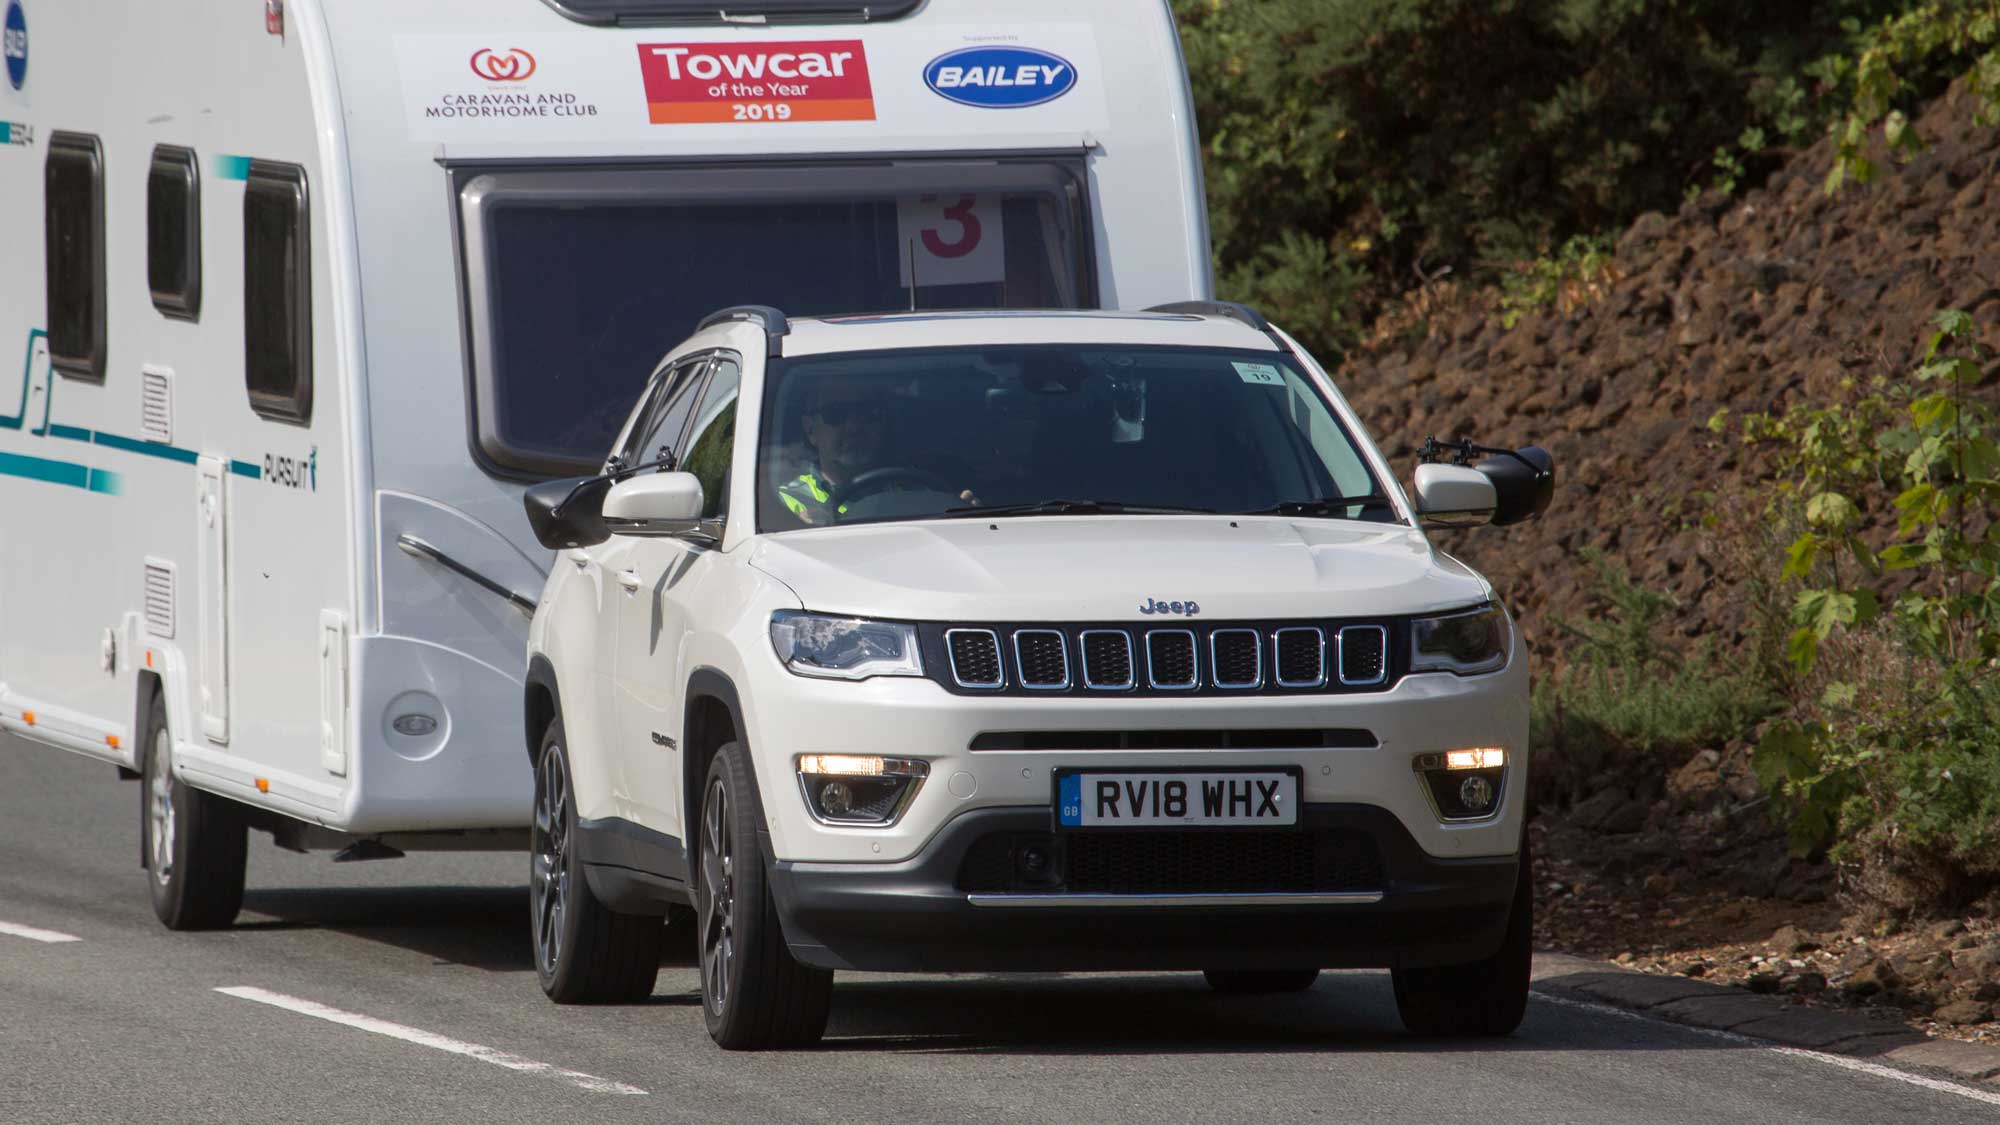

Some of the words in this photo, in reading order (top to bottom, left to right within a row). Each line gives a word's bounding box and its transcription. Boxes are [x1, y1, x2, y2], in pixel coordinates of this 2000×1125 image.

[652, 47, 852, 80] Towcar
[935, 64, 1065, 88] BAILEY
[442, 94, 530, 106] CARAVAN
[536, 93, 576, 104] AND
[708, 83, 728, 97] of
[731, 83, 764, 96] the
[767, 82, 809, 96] Year
[426, 106, 548, 118] MOTORHOME
[553, 105, 598, 116] CLUB
[732, 103, 791, 120] 2019
[920, 193, 982, 258] 3
[263, 453, 308, 489] PURSUIT
[1139, 597, 1200, 617] Jeep
[1096, 781, 1187, 818] RV18
[1202, 780, 1280, 818] WHX
[1064, 806, 1079, 817] GB
